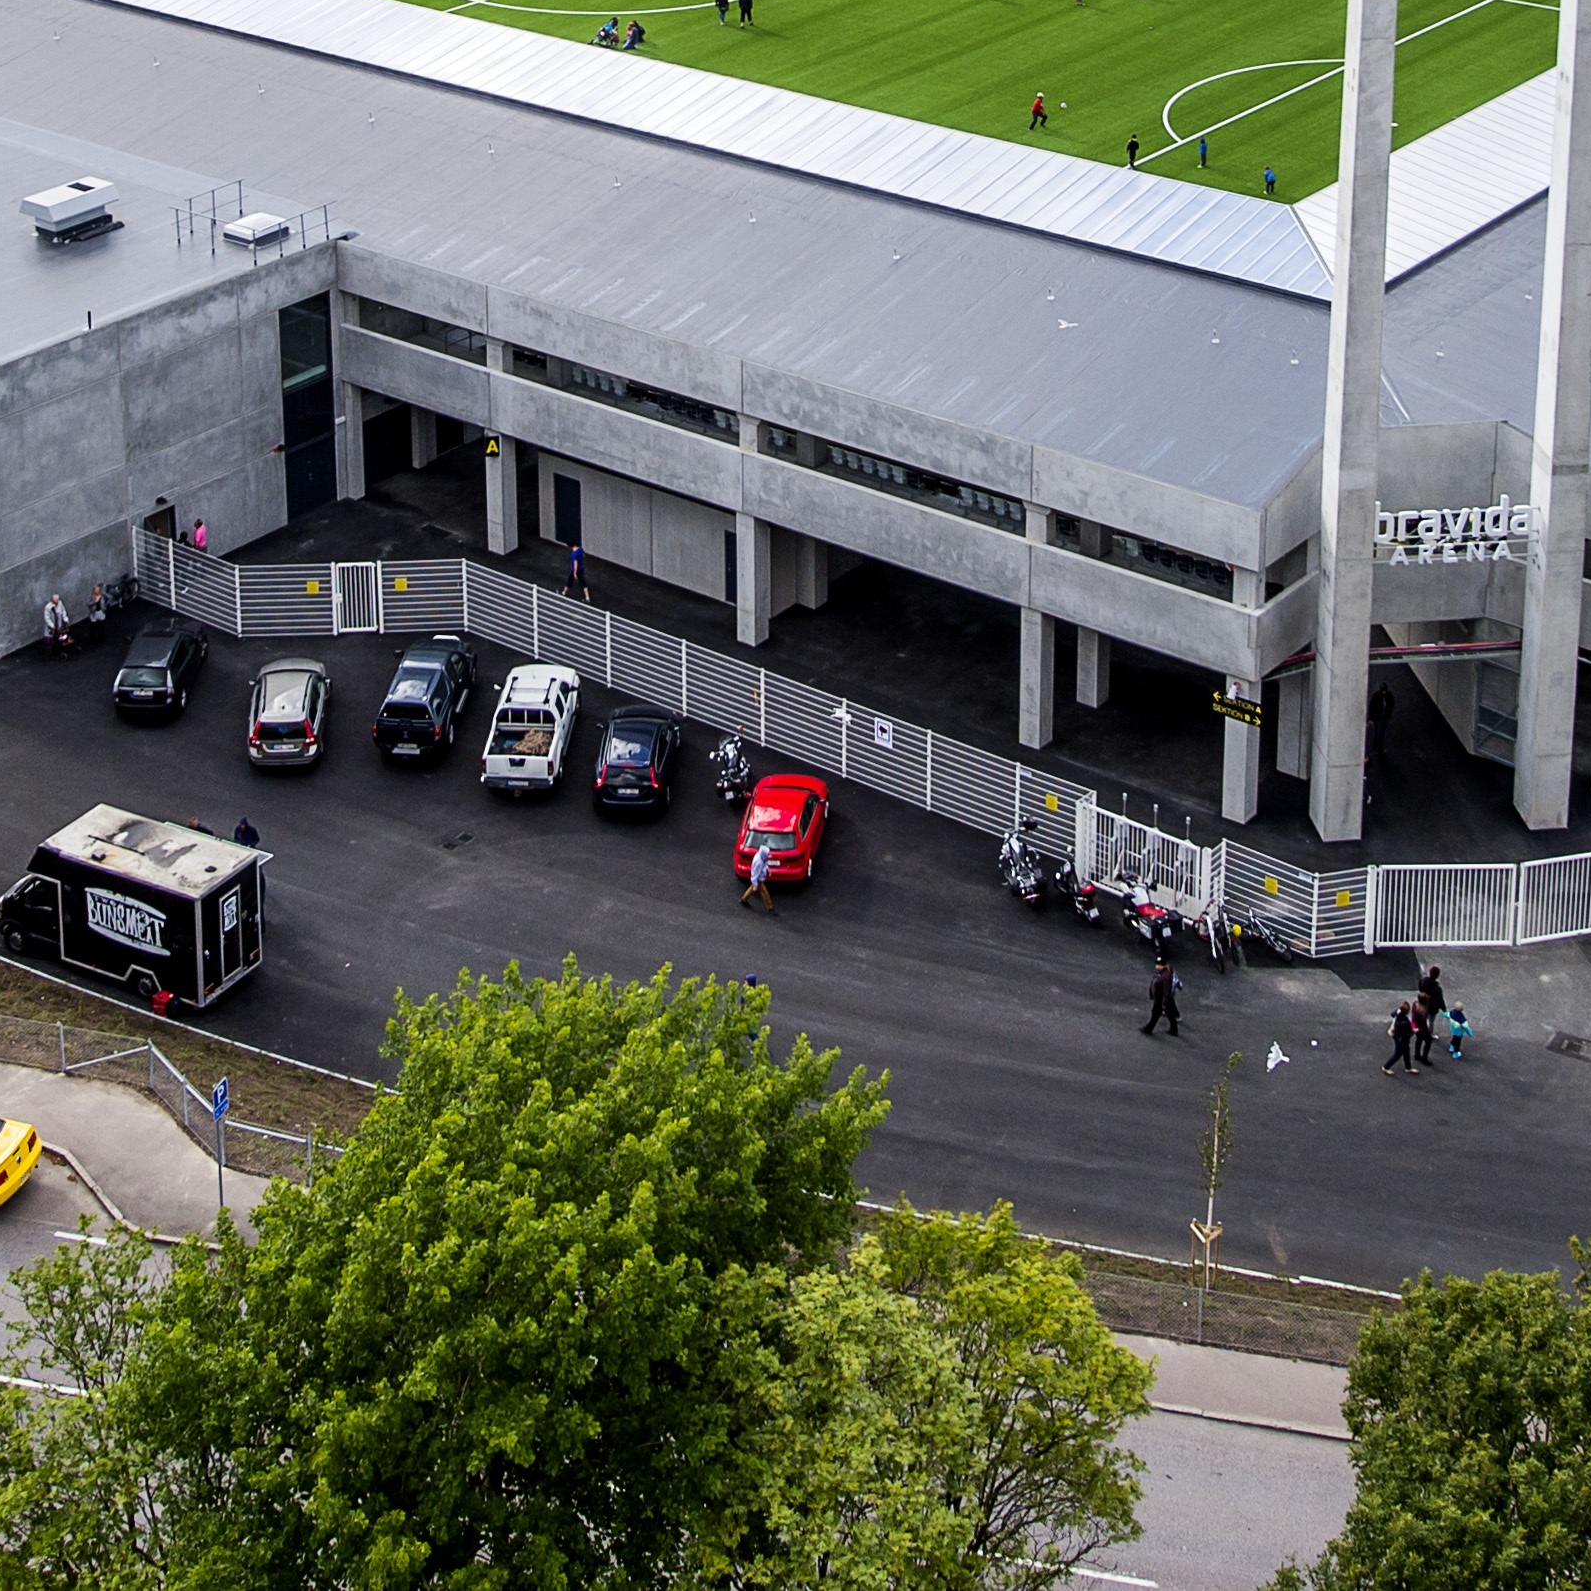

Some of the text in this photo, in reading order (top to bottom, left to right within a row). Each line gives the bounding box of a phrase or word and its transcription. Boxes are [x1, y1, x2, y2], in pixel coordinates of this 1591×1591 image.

[485, 439, 499, 454] A
[1374, 494, 1533, 542] bravida
[1389, 540, 1512, 566] ARENA
[217, 1084, 225, 1104] P
